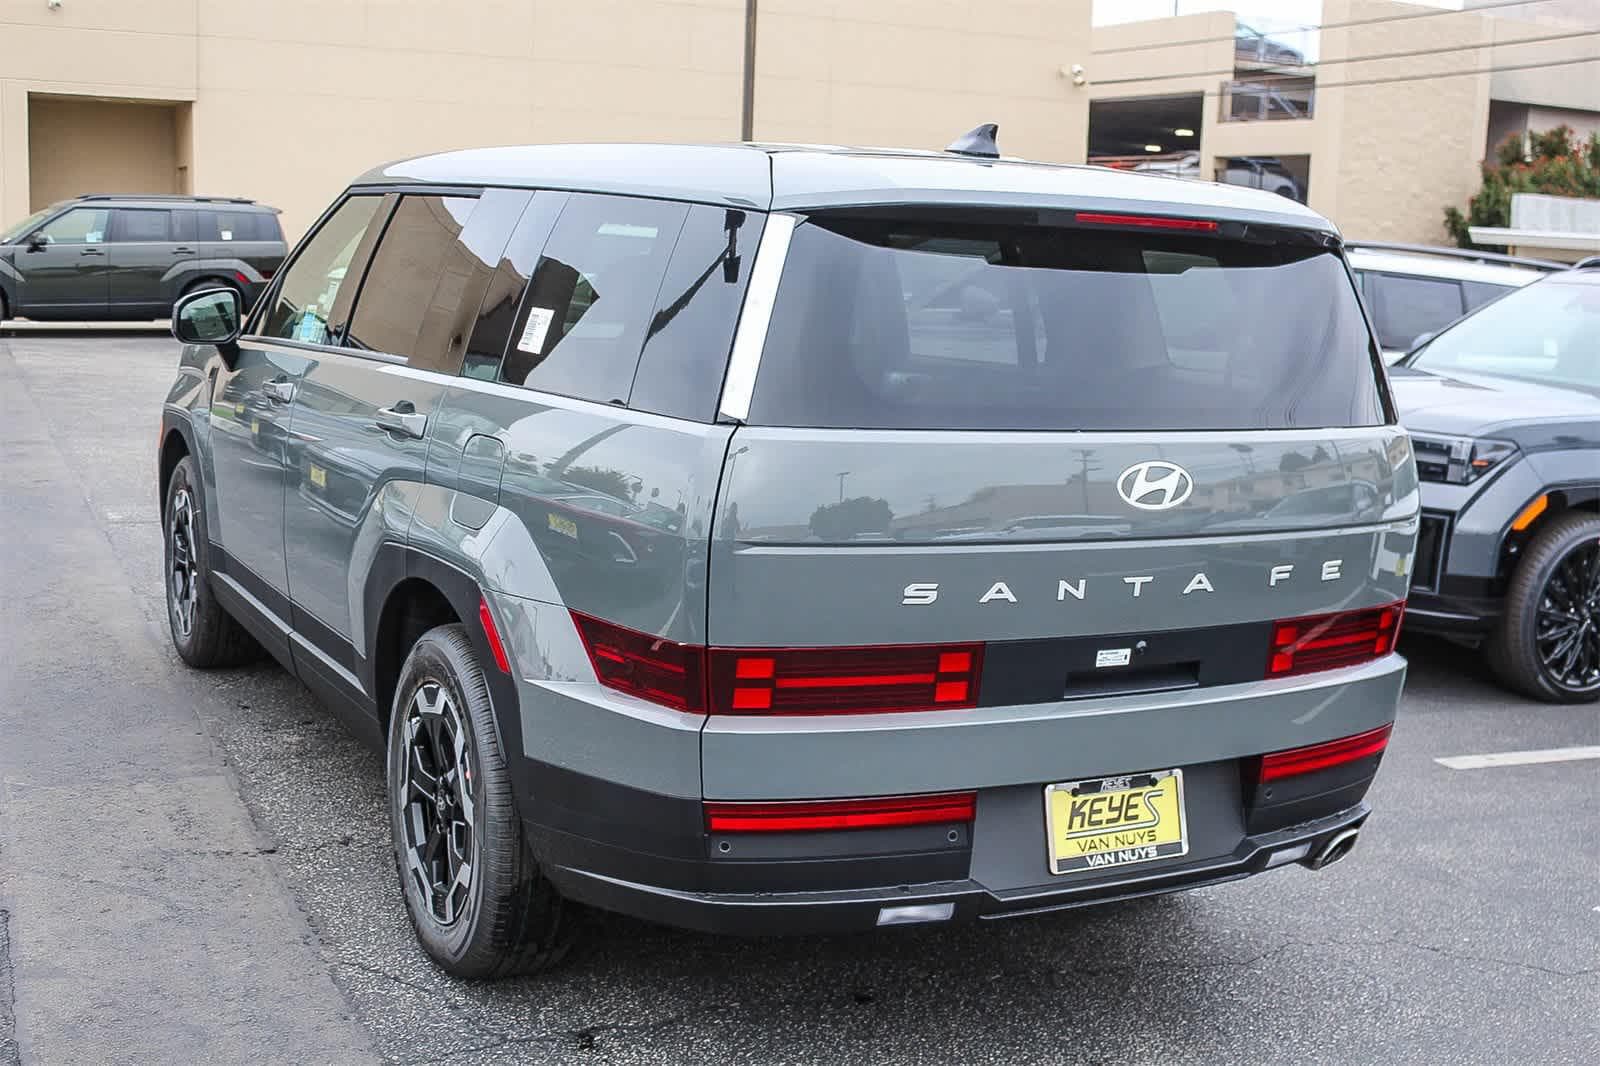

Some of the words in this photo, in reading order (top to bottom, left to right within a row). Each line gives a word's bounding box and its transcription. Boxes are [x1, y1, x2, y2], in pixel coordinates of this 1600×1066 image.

[901, 572, 1215, 605] SANTA
[1269, 558, 1343, 587] FE
[1101, 776, 1133, 791] KEYES
[1067, 788, 1164, 832] KEYES
[1077, 836, 1110, 853] VAN
[1114, 829, 1157, 847] NUYS
[1086, 852, 1115, 868] VAN
[1118, 846, 1158, 863] NUYS
